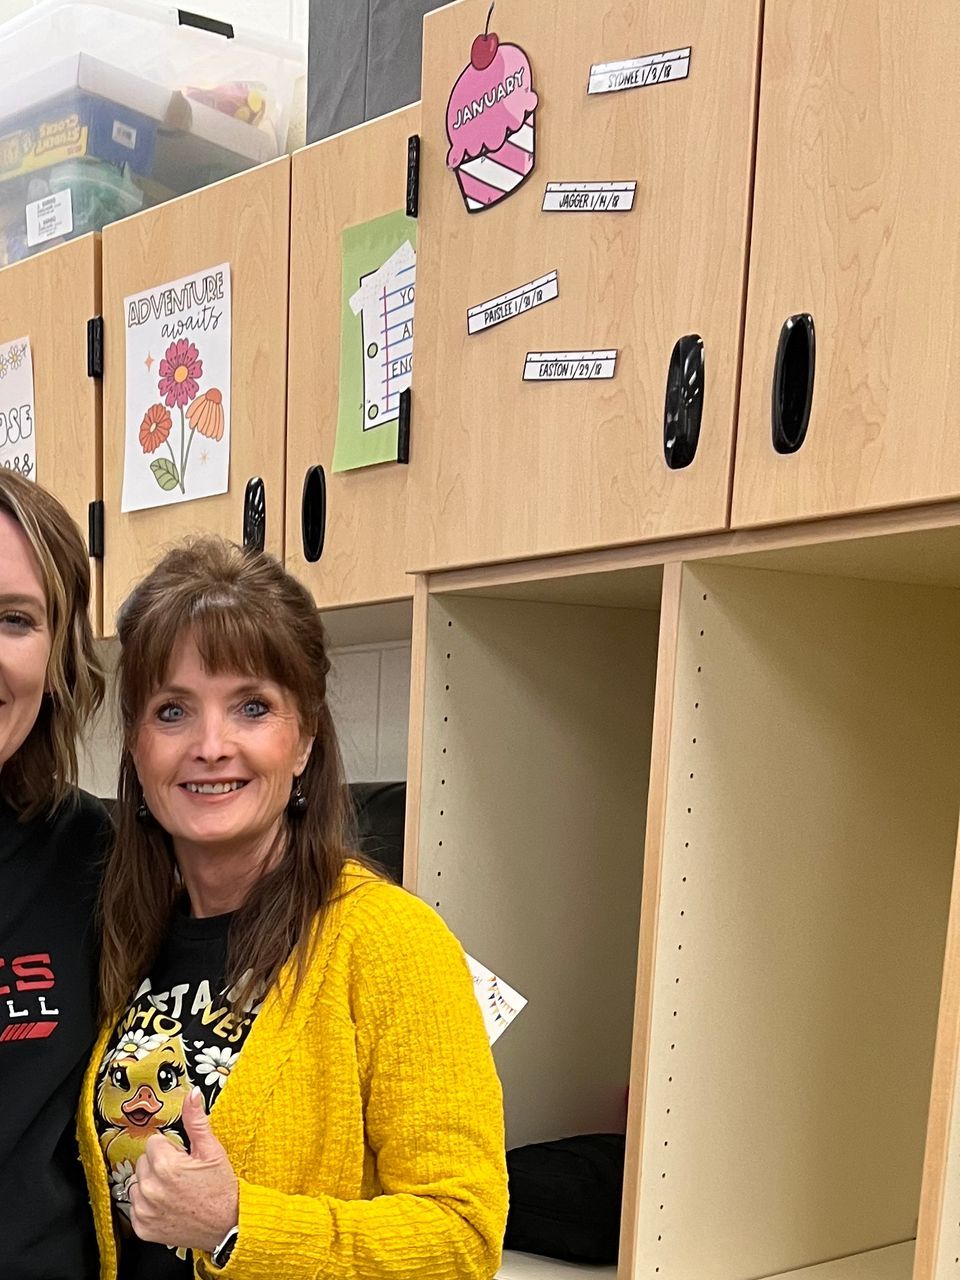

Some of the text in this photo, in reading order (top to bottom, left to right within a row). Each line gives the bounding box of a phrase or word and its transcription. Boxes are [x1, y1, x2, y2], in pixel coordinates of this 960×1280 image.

[453, 67, 525, 130] JANUARY
[559, 193, 589, 209] JAGGER
[127, 272, 224, 328] ADVENTURE
[484, 299, 513, 325] PAISLEE
[161, 303, 223, 339] awaits
[539, 362, 569, 377] EASTON
